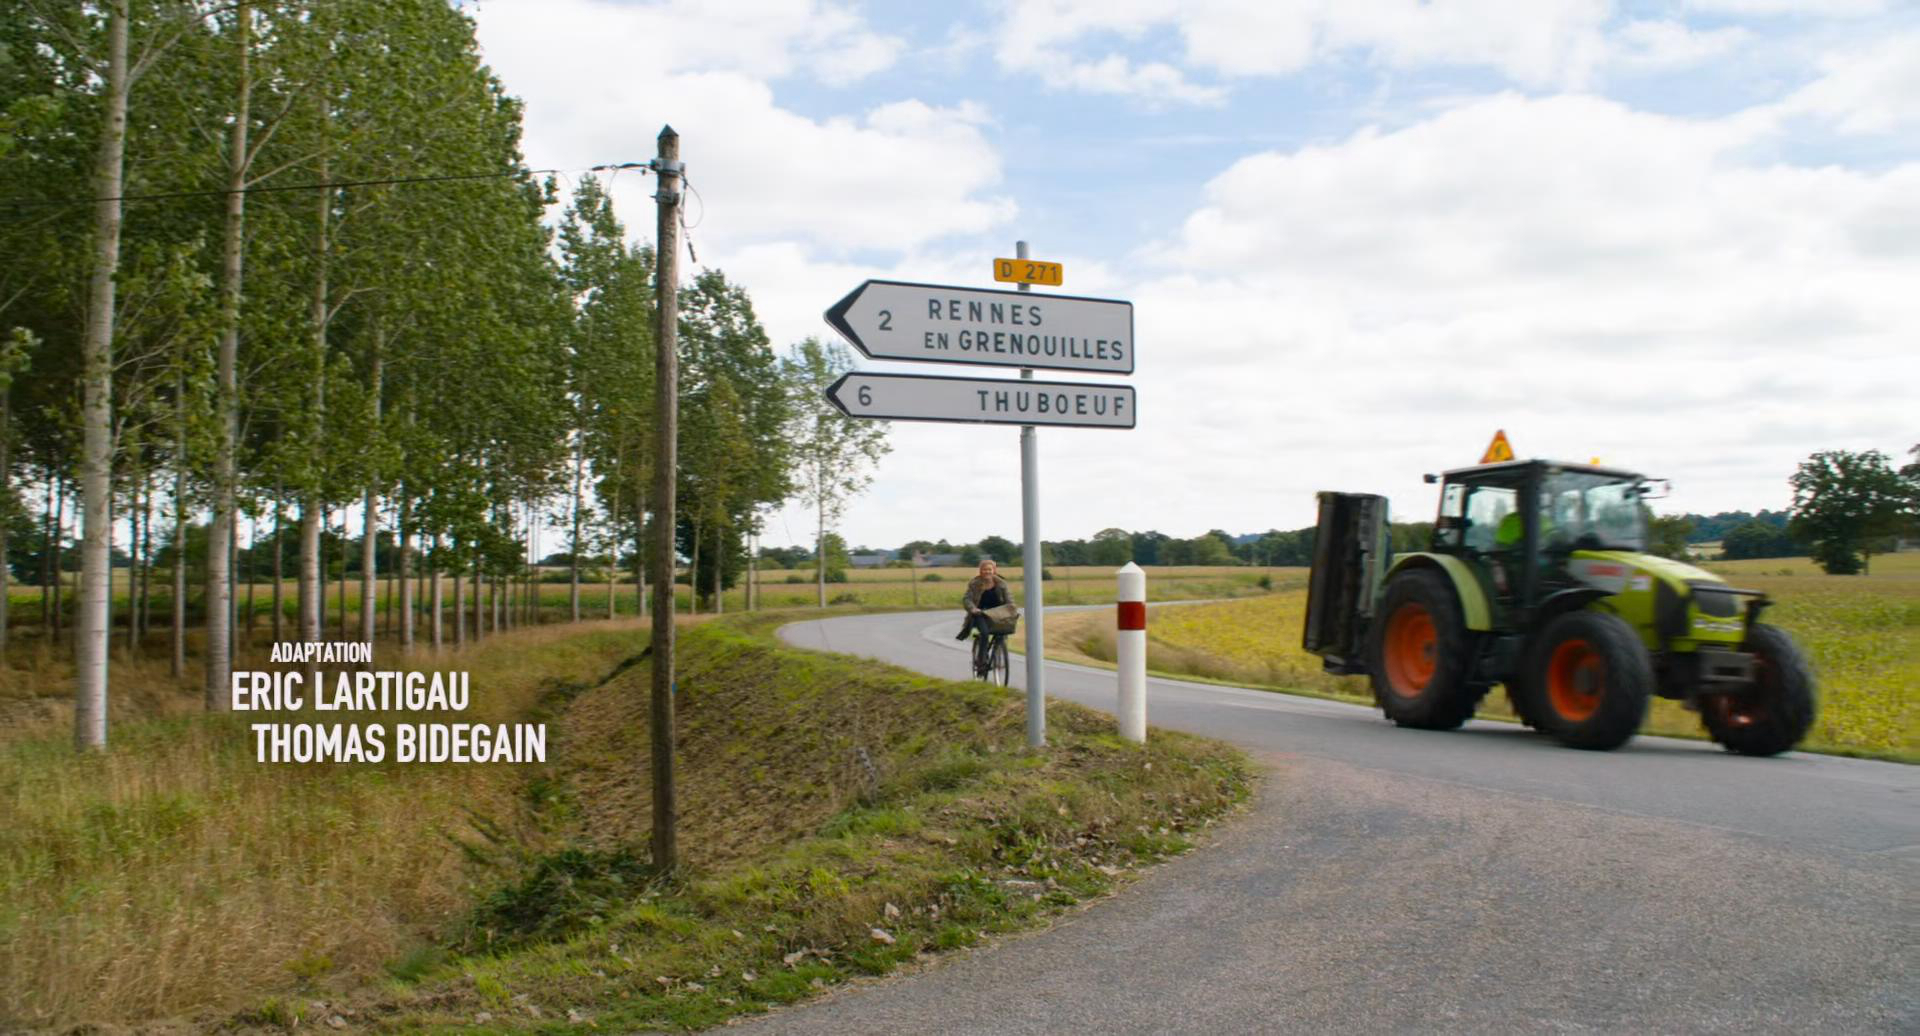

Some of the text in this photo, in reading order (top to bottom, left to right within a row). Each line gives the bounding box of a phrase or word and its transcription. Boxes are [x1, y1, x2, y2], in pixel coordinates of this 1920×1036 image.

[1001, 262, 1058, 283] D 271
[878, 310, 893, 331] 2
[928, 298, 1042, 326] RENNES
[924, 330, 1123, 360] EN GRENOUILLES
[858, 385, 1125, 416] 6 THUBOEUF
